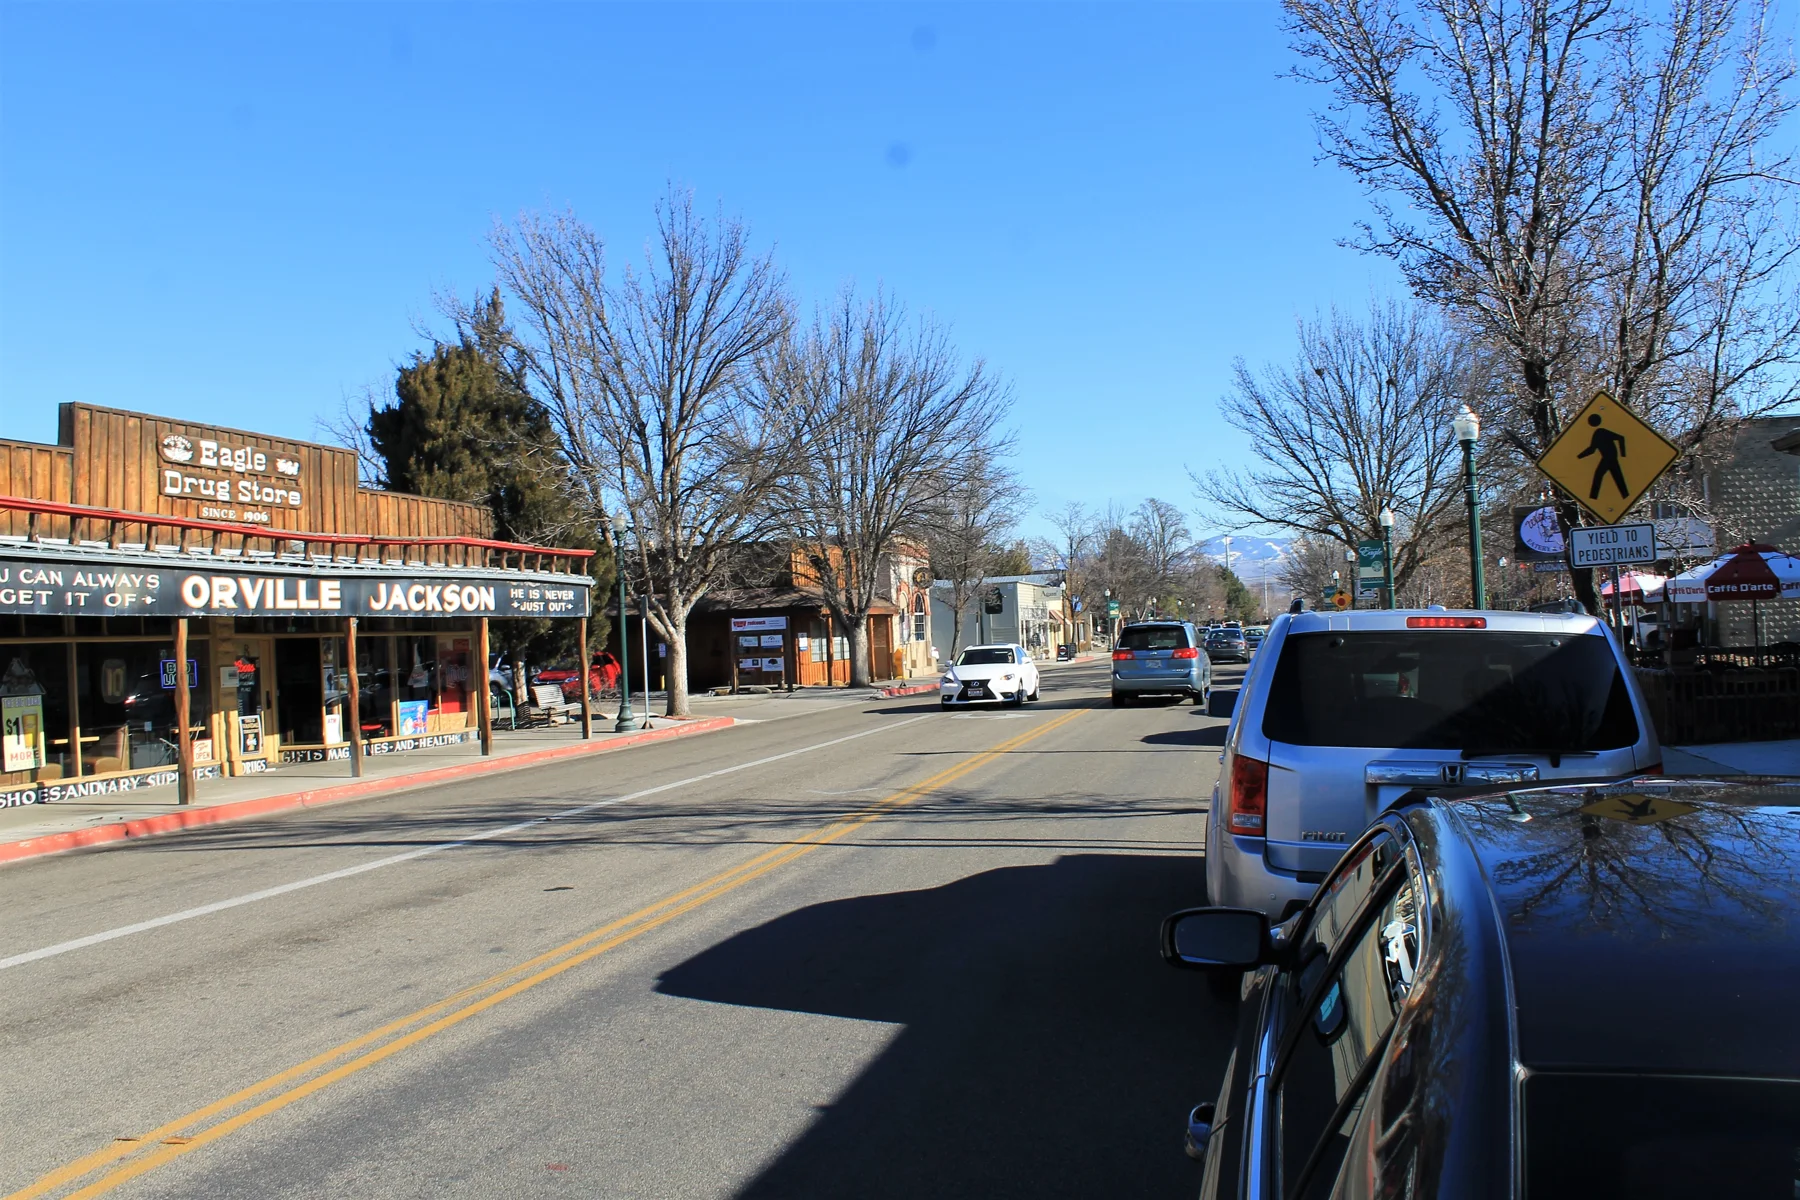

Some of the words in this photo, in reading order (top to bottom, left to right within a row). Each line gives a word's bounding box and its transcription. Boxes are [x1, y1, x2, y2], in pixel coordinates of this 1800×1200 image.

[199, 440, 267, 472] Eagle
[164, 469, 231, 501] Drug
[238, 480, 301, 505] Store
[201, 507, 237, 520] SINCE
[243, 511, 269, 522] 1906
[1588, 531, 1618, 544] YIELD
[1625, 530, 1638, 542] TO
[1526, 539, 1551, 552] EATERY
[1578, 546, 1649, 562] PEDESTRIANS
[19, 569, 63, 587] CAN
[72, 571, 160, 588] ALWAYS
[0, 588, 53, 605] GET
[64, 591, 91, 606] IT
[103, 593, 137, 607] OF
[181, 575, 341, 610] ORVILLE
[369, 583, 496, 612] JACKSON
[510, 588, 525, 599] HE
[529, 589, 540, 599] IS
[545, 590, 575, 600] NEVER
[520, 601, 546, 611] JUST
[549, 602, 567, 611] OUT
[6, 717, 20, 745] $1
[394, 739, 415, 752] AND
[10, 749, 39, 762] MORE
[0, 786, 61, 809] SHOES
[1301, 830, 1346, 841] PILOT
